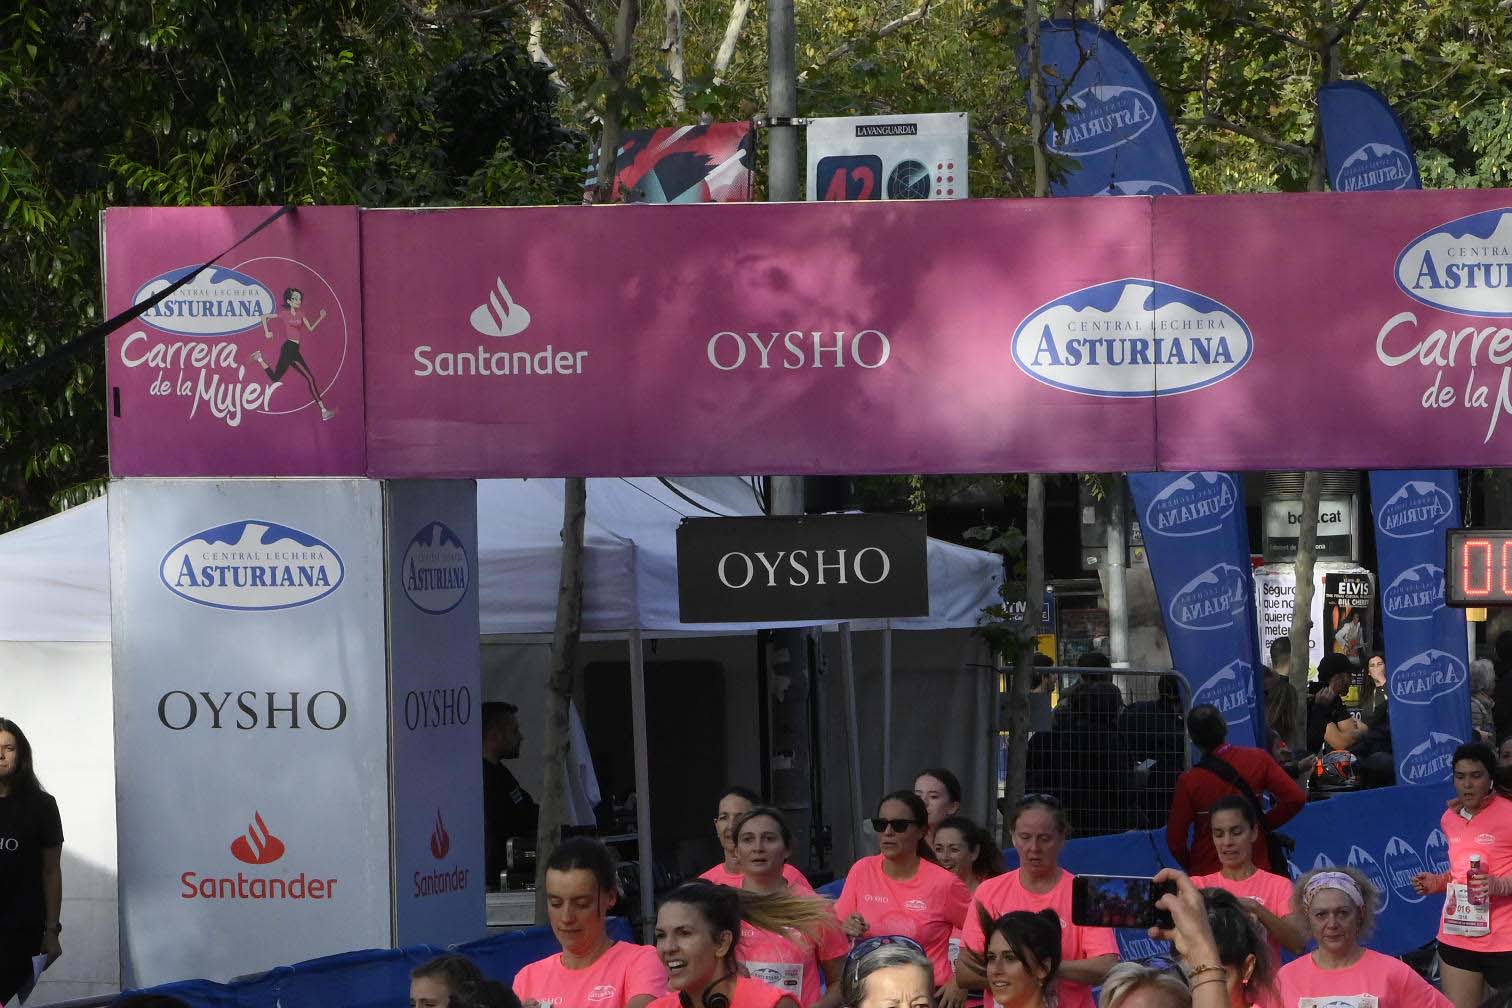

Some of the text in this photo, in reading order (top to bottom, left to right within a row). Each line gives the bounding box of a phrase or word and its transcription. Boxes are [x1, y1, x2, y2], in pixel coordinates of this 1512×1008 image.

[1067, 318, 1226, 333] CENTRAL LECHERA
[121, 331, 238, 369] Carrera
[414, 345, 588, 376] Santander
[707, 330, 891, 371] OYSHO
[1031, 323, 1234, 367] ASTURIANA
[150, 365, 283, 427] de la Mujer
[1421, 370, 1456, 408] de
[1464, 369, 1489, 408] la
[174, 554, 331, 588] ASTURIANA
[202, 550, 325, 560] CENTRAL LECHERA
[718, 547, 890, 589] OYSHO
[1338, 582, 1369, 596] ELVIS
[157, 690, 347, 731] OYSHO
[405, 686, 471, 731] OYSHO
[179, 870, 338, 899] Santander
[413, 864, 470, 898] Santander
[1457, 905, 1471, 914] 016
